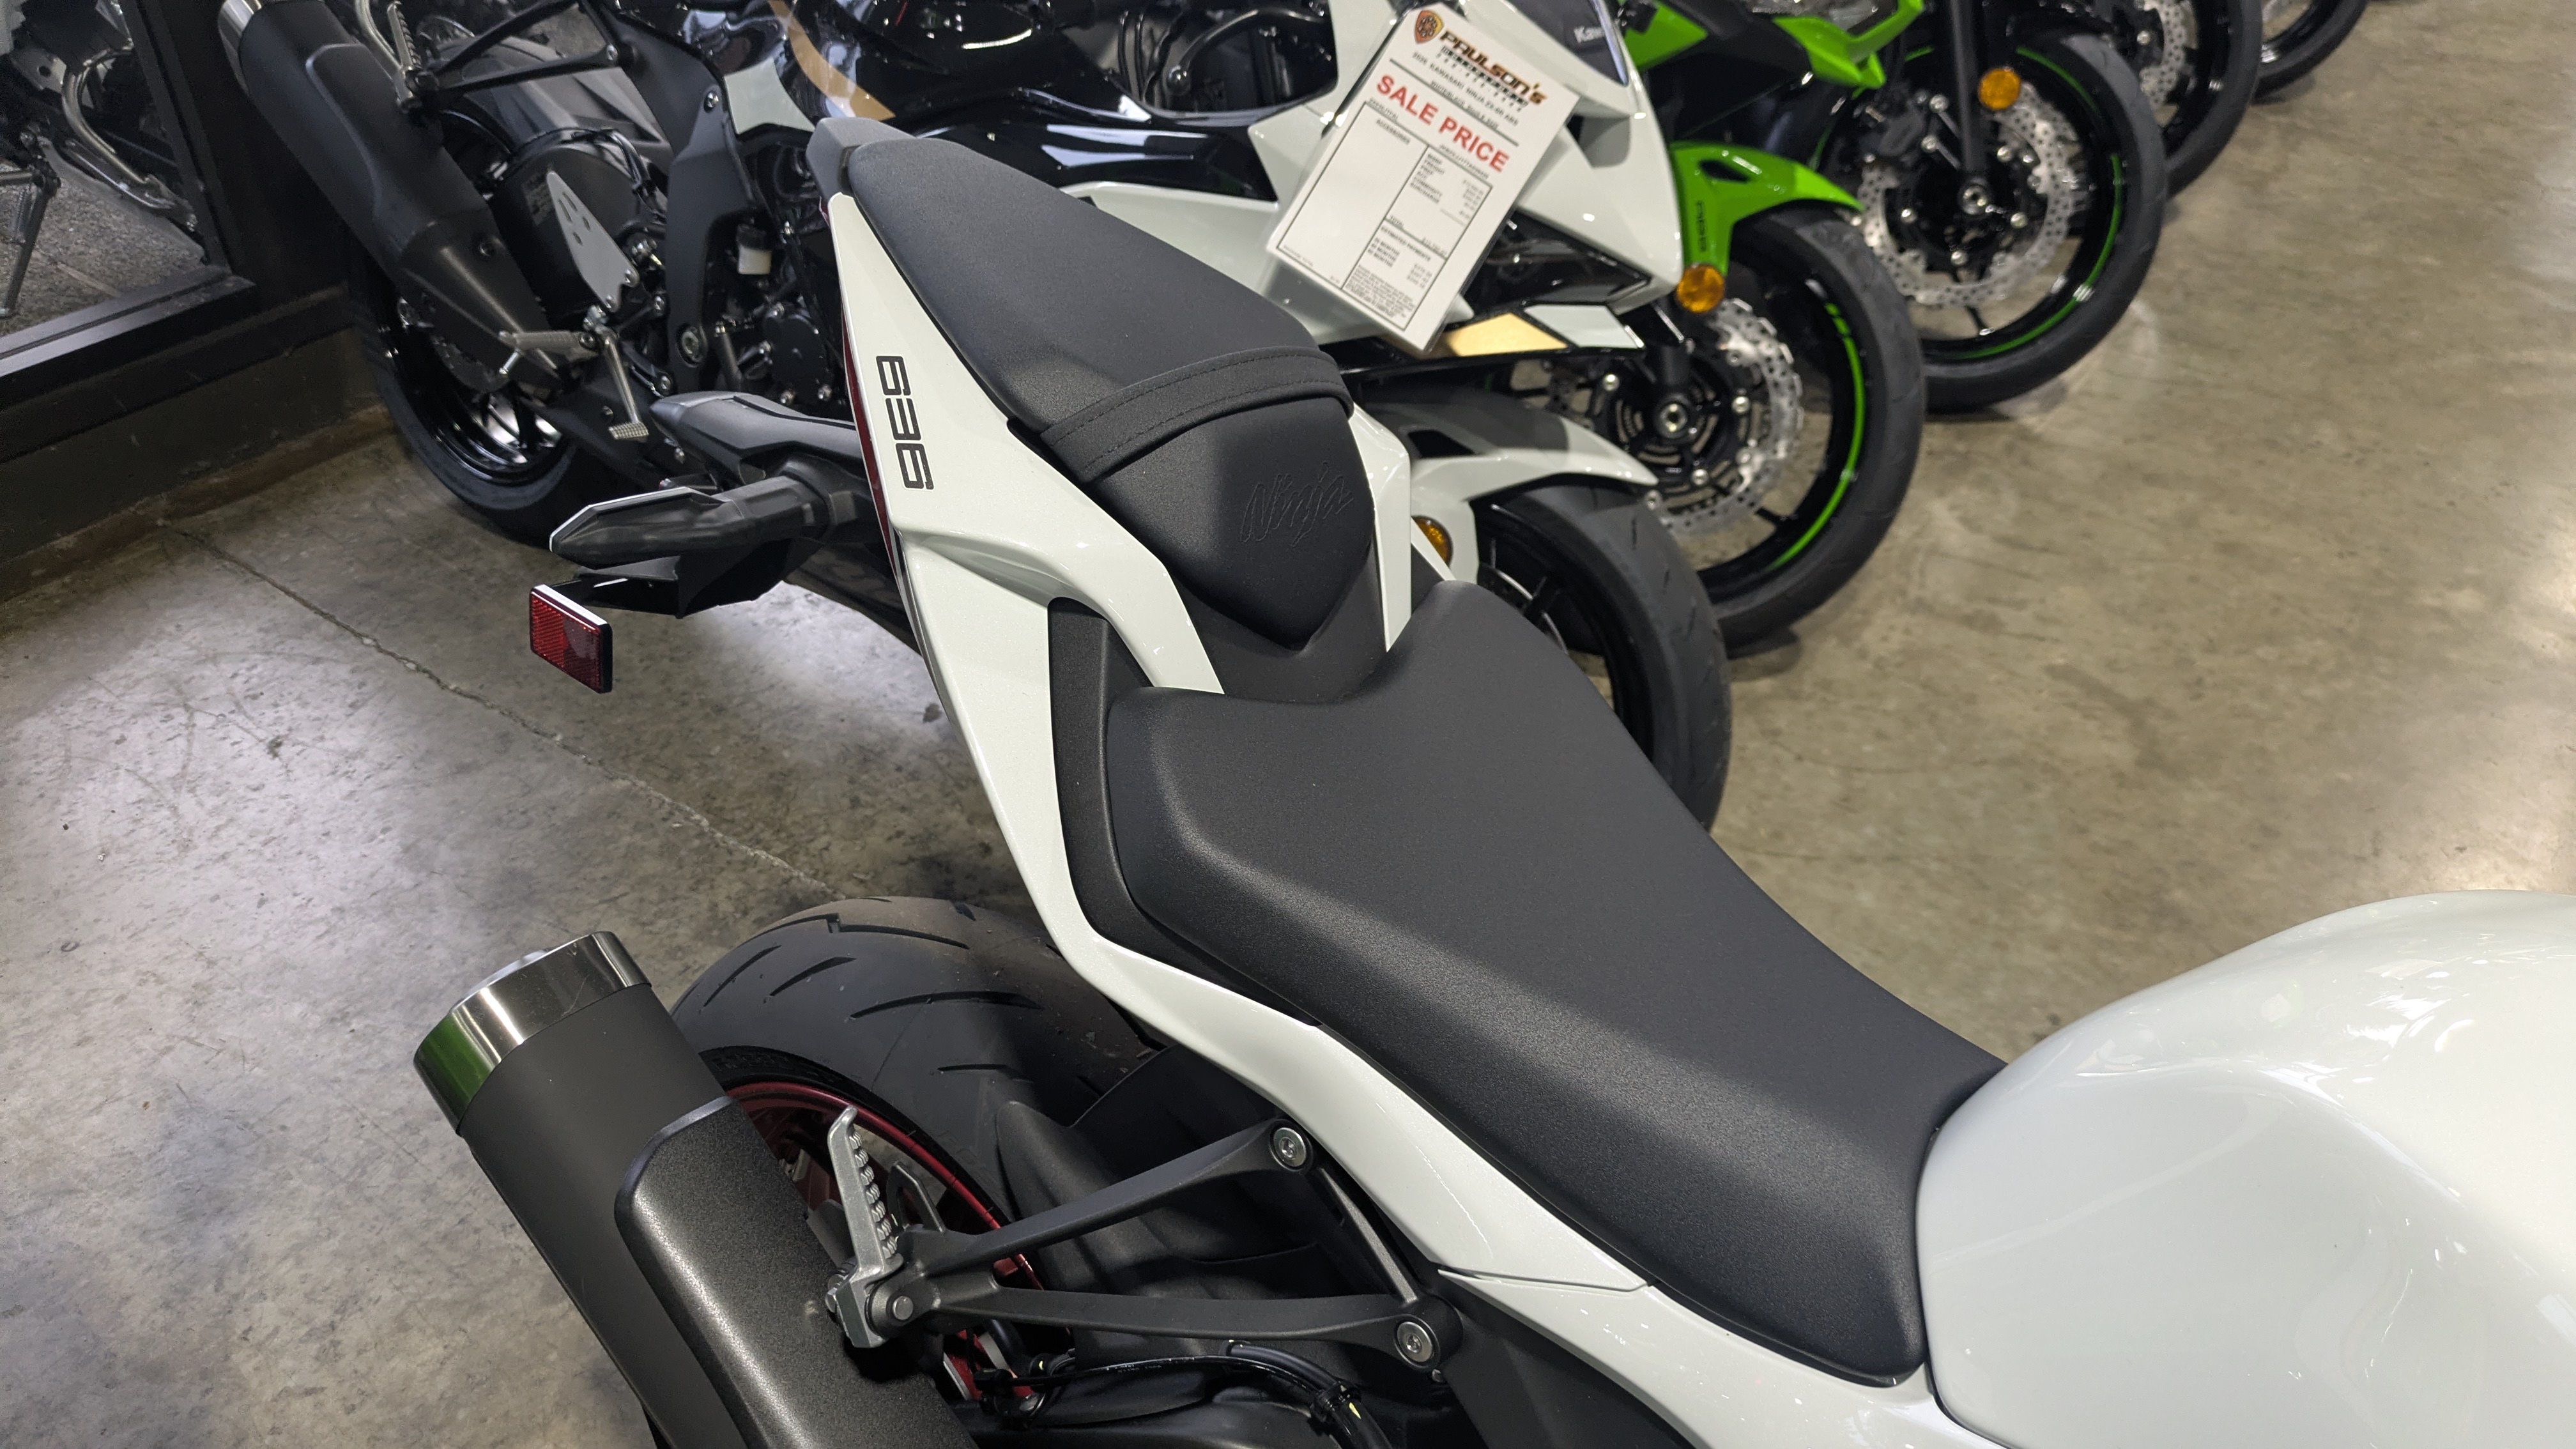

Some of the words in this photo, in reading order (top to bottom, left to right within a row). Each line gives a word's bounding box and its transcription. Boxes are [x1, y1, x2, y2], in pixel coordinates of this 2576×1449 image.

[1374, 72, 1439, 126] SALE
[1438, 114, 1510, 173] PRICE
[876, 355, 934, 491] 636
[1238, 459, 1354, 548] Ninja
